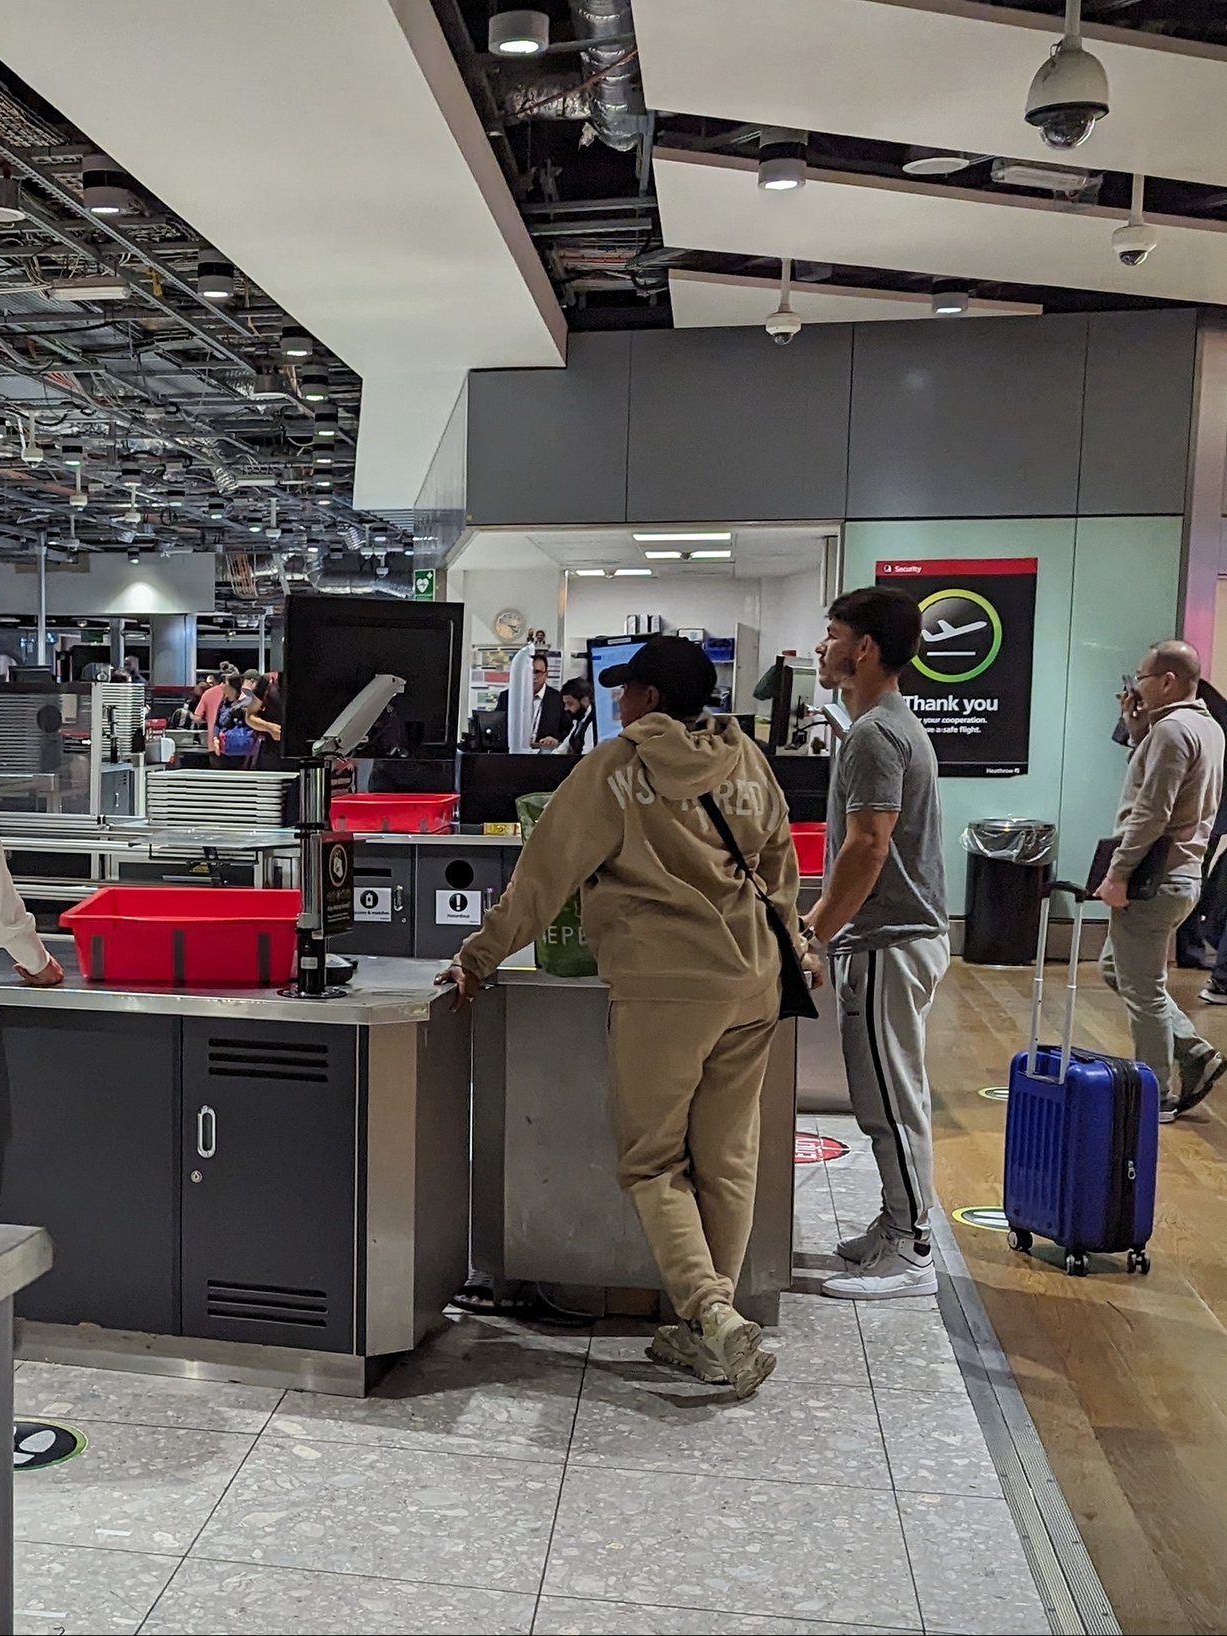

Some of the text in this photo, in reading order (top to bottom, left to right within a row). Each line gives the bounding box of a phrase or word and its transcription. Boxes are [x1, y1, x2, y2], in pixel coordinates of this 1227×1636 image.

[894, 565, 922, 574] Security
[902, 695, 999, 715] Thank you
[923, 717, 941, 725] your
[941, 716, 988, 725] cooperation.
[959, 725, 982, 735] flight.
